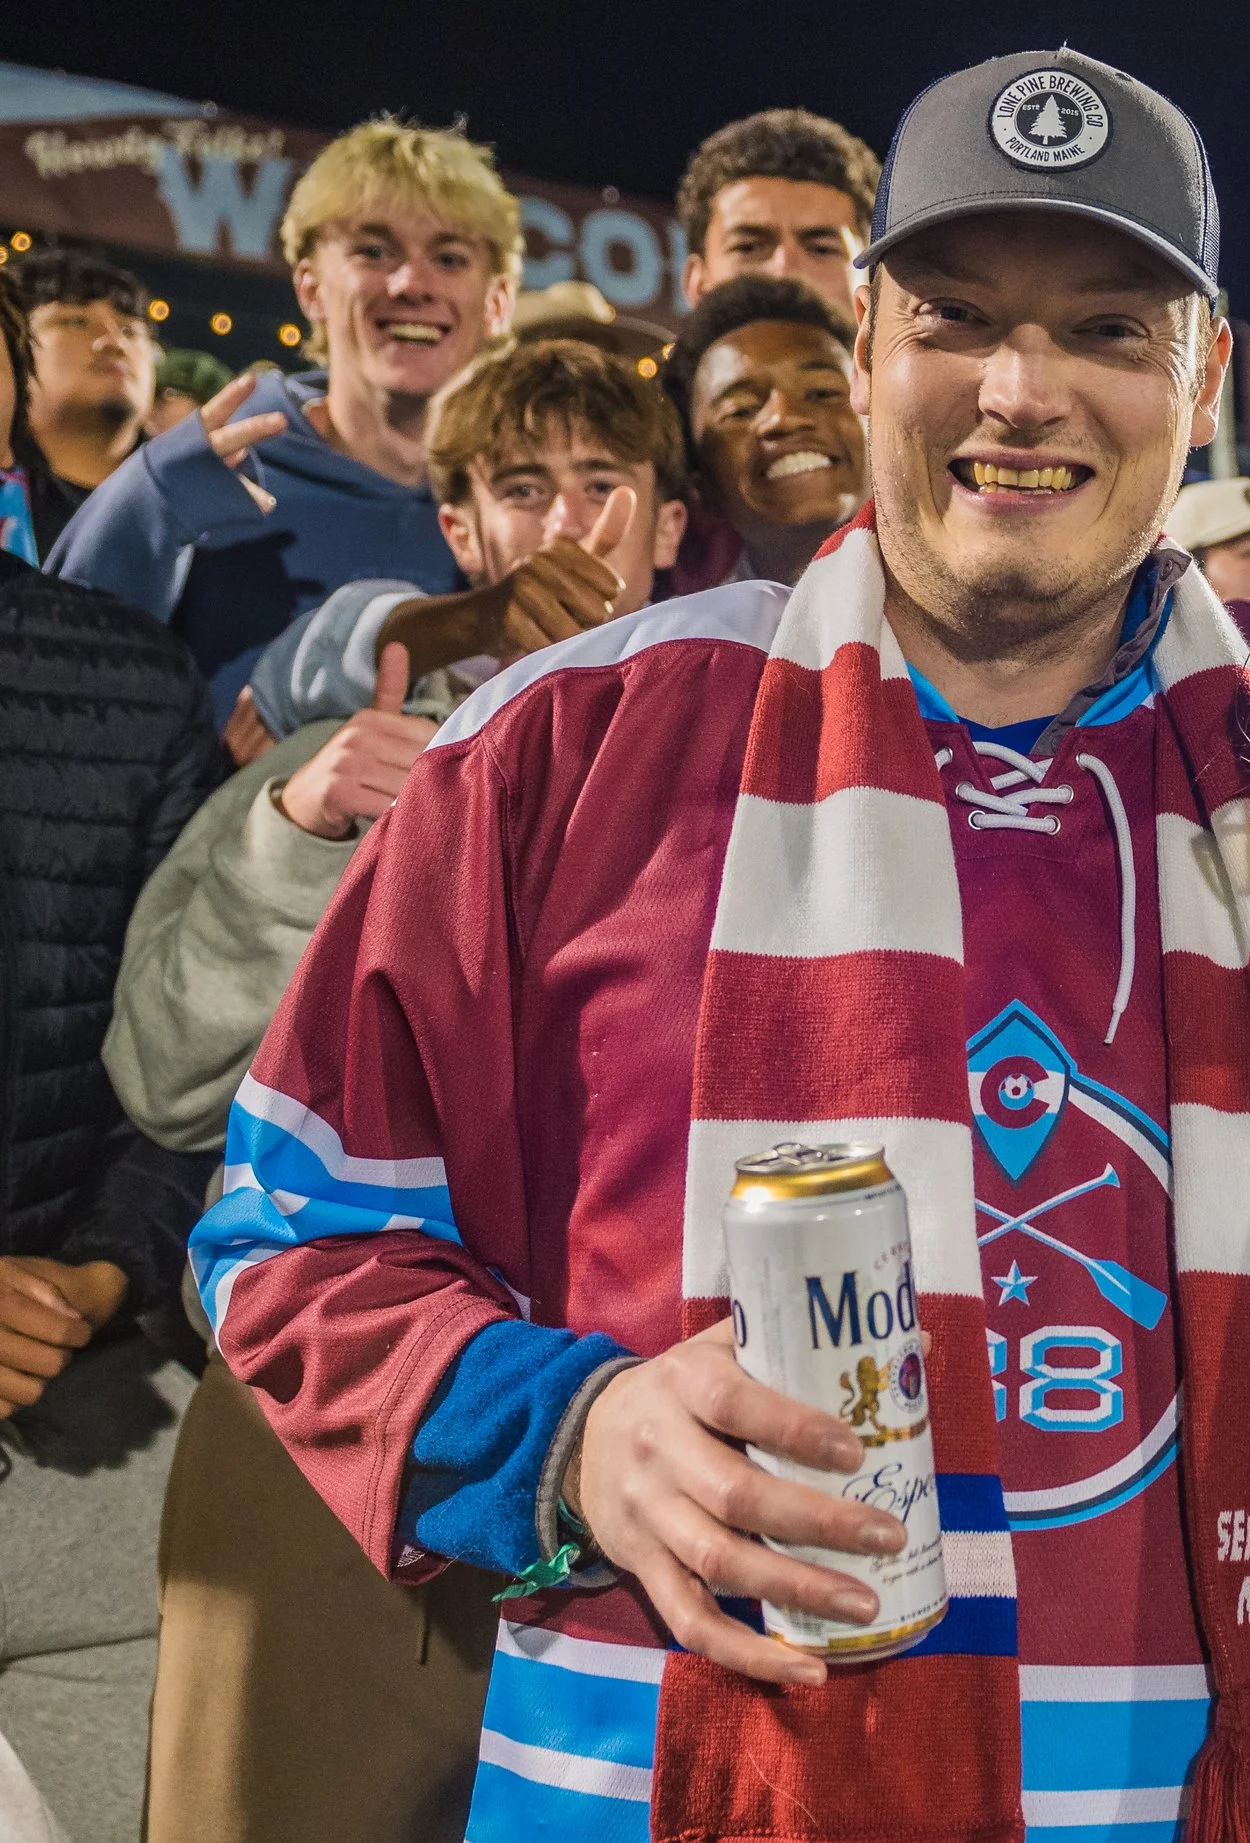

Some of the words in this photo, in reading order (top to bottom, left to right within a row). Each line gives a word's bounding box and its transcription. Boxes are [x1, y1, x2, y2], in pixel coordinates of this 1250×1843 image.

[996, 91, 1022, 118] LONE
[1016, 76, 1047, 96] PINE
[1049, 75, 1100, 112] BREWING
[1086, 114, 1104, 128] CO
[1005, 136, 1051, 162] PORTLAND
[1053, 144, 1085, 162] MAINE
[986, 1325, 1124, 1432] 8
